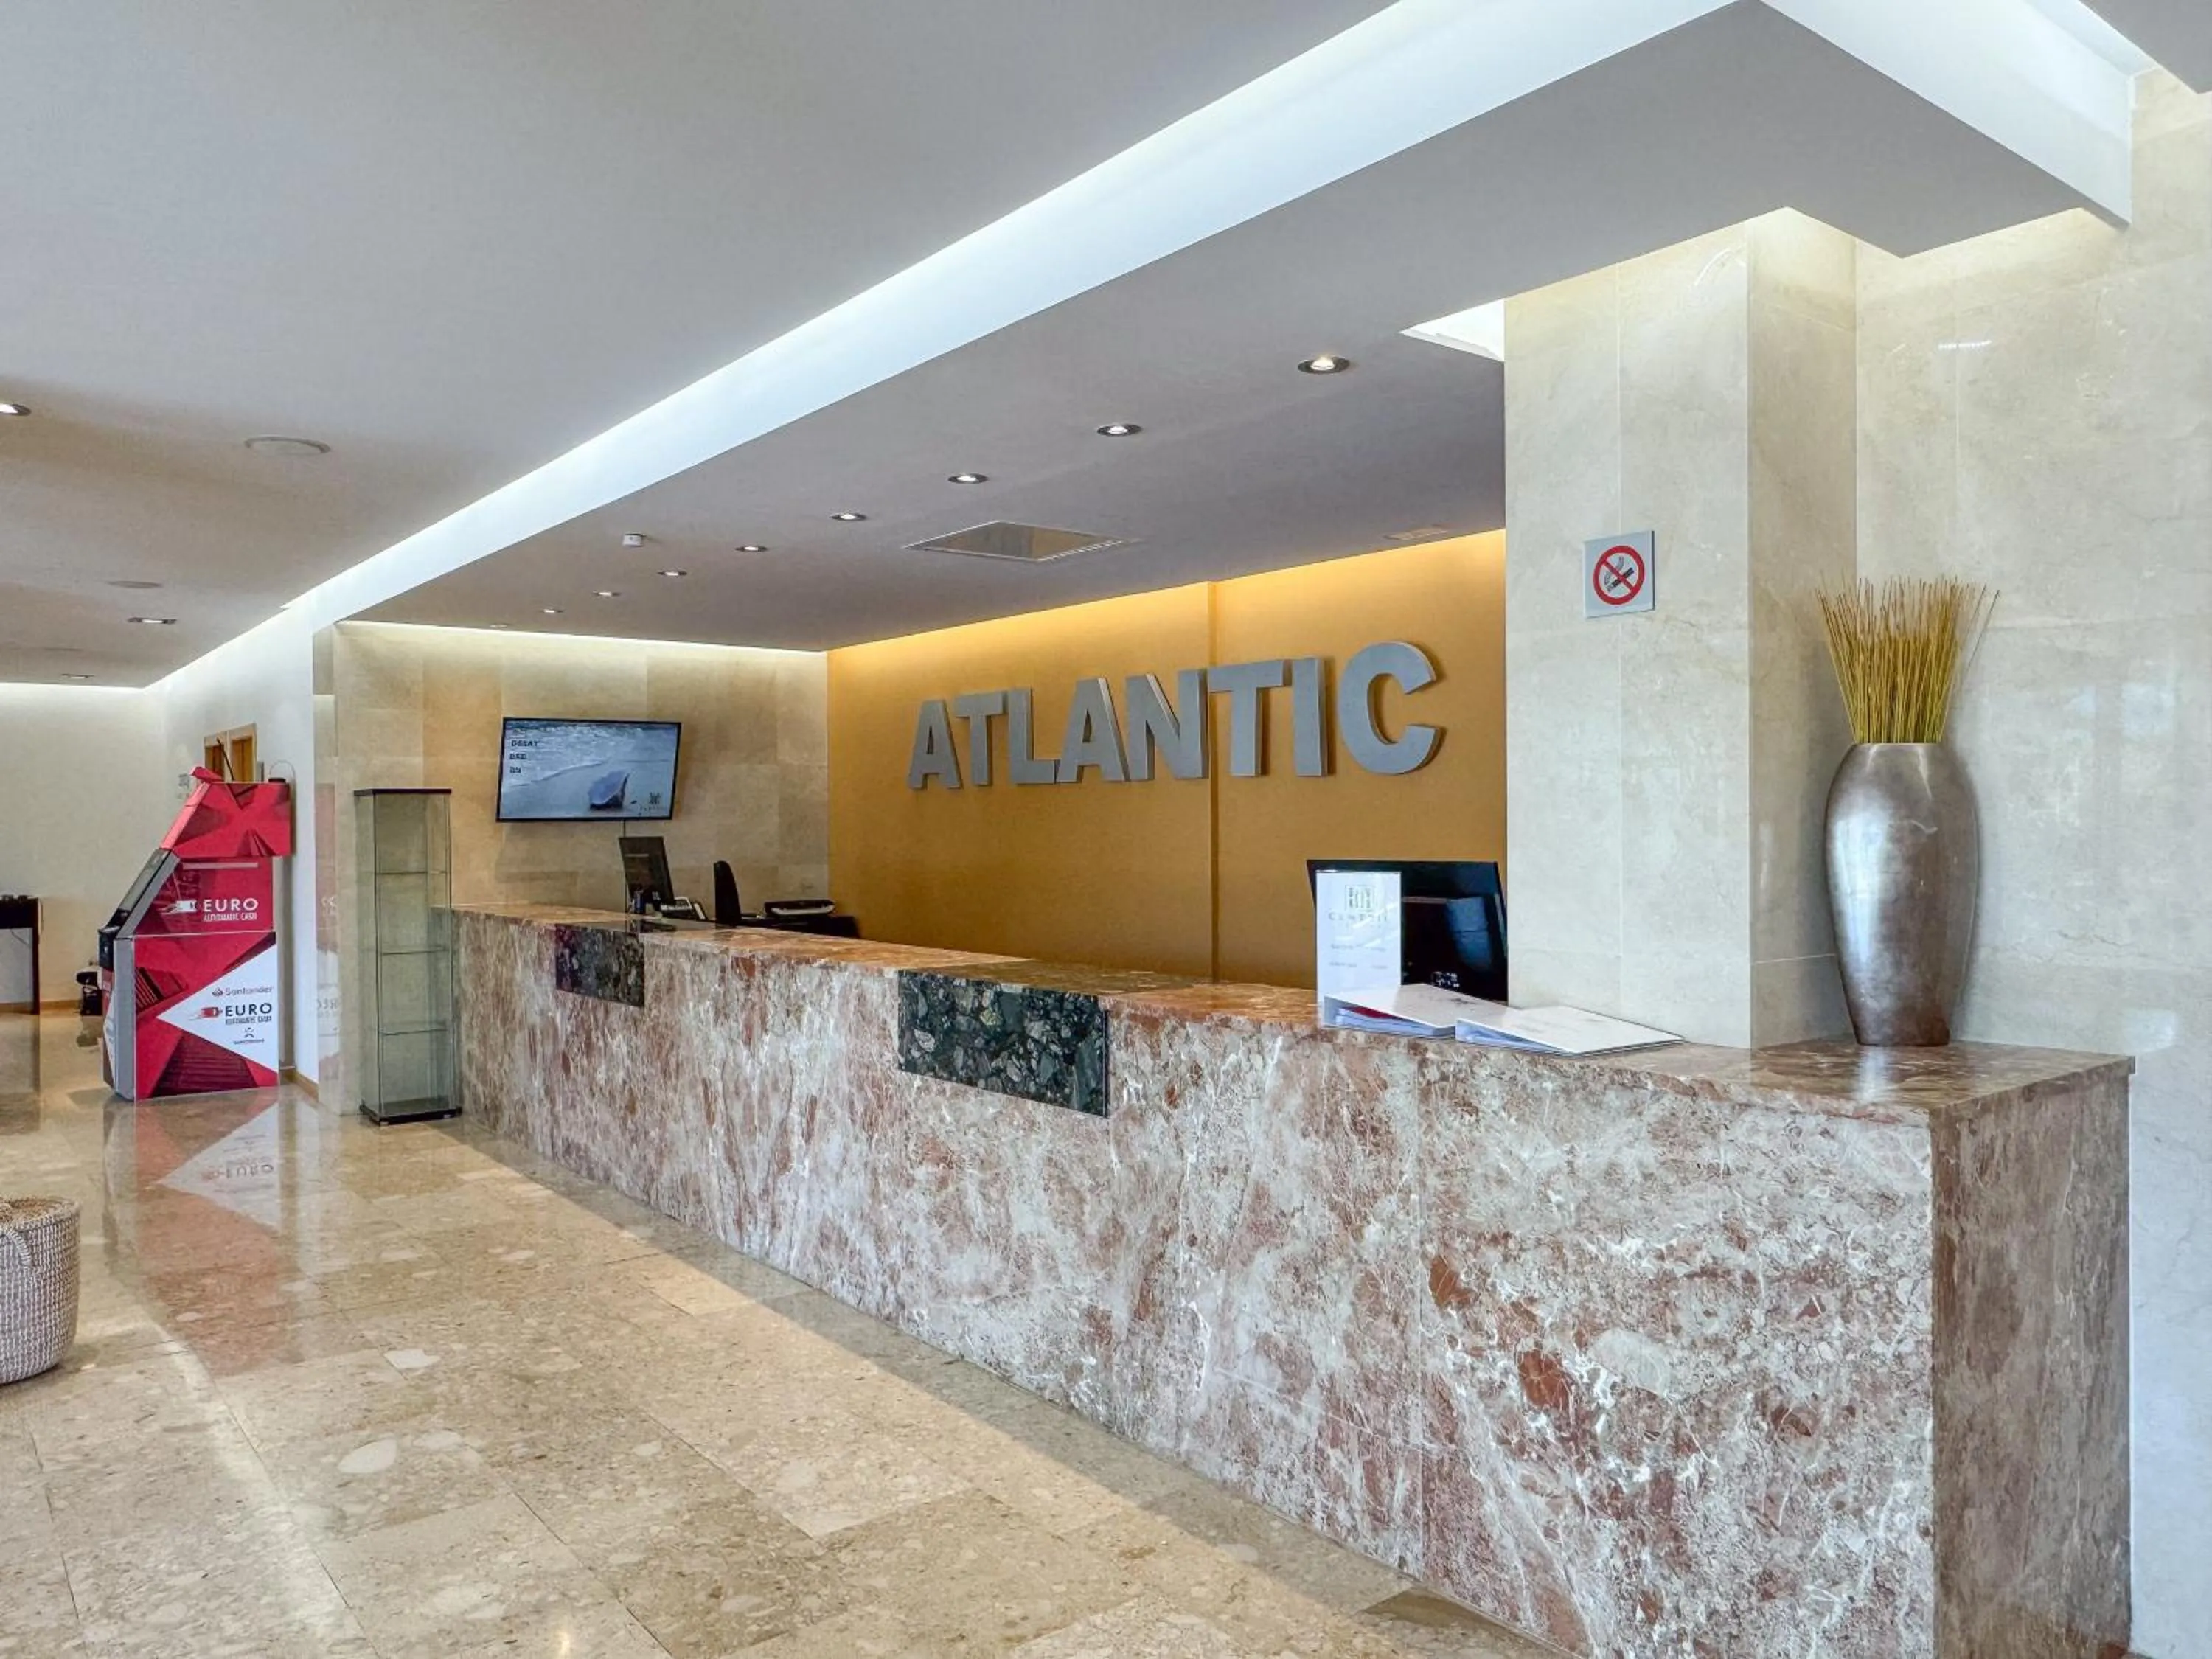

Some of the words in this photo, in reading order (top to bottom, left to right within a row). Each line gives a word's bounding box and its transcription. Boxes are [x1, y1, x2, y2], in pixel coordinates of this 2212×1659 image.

[908, 641, 1441, 790] ATLANTIC
[203, 897, 259, 912] EURO
[225, 1003, 272, 1017] EURO
